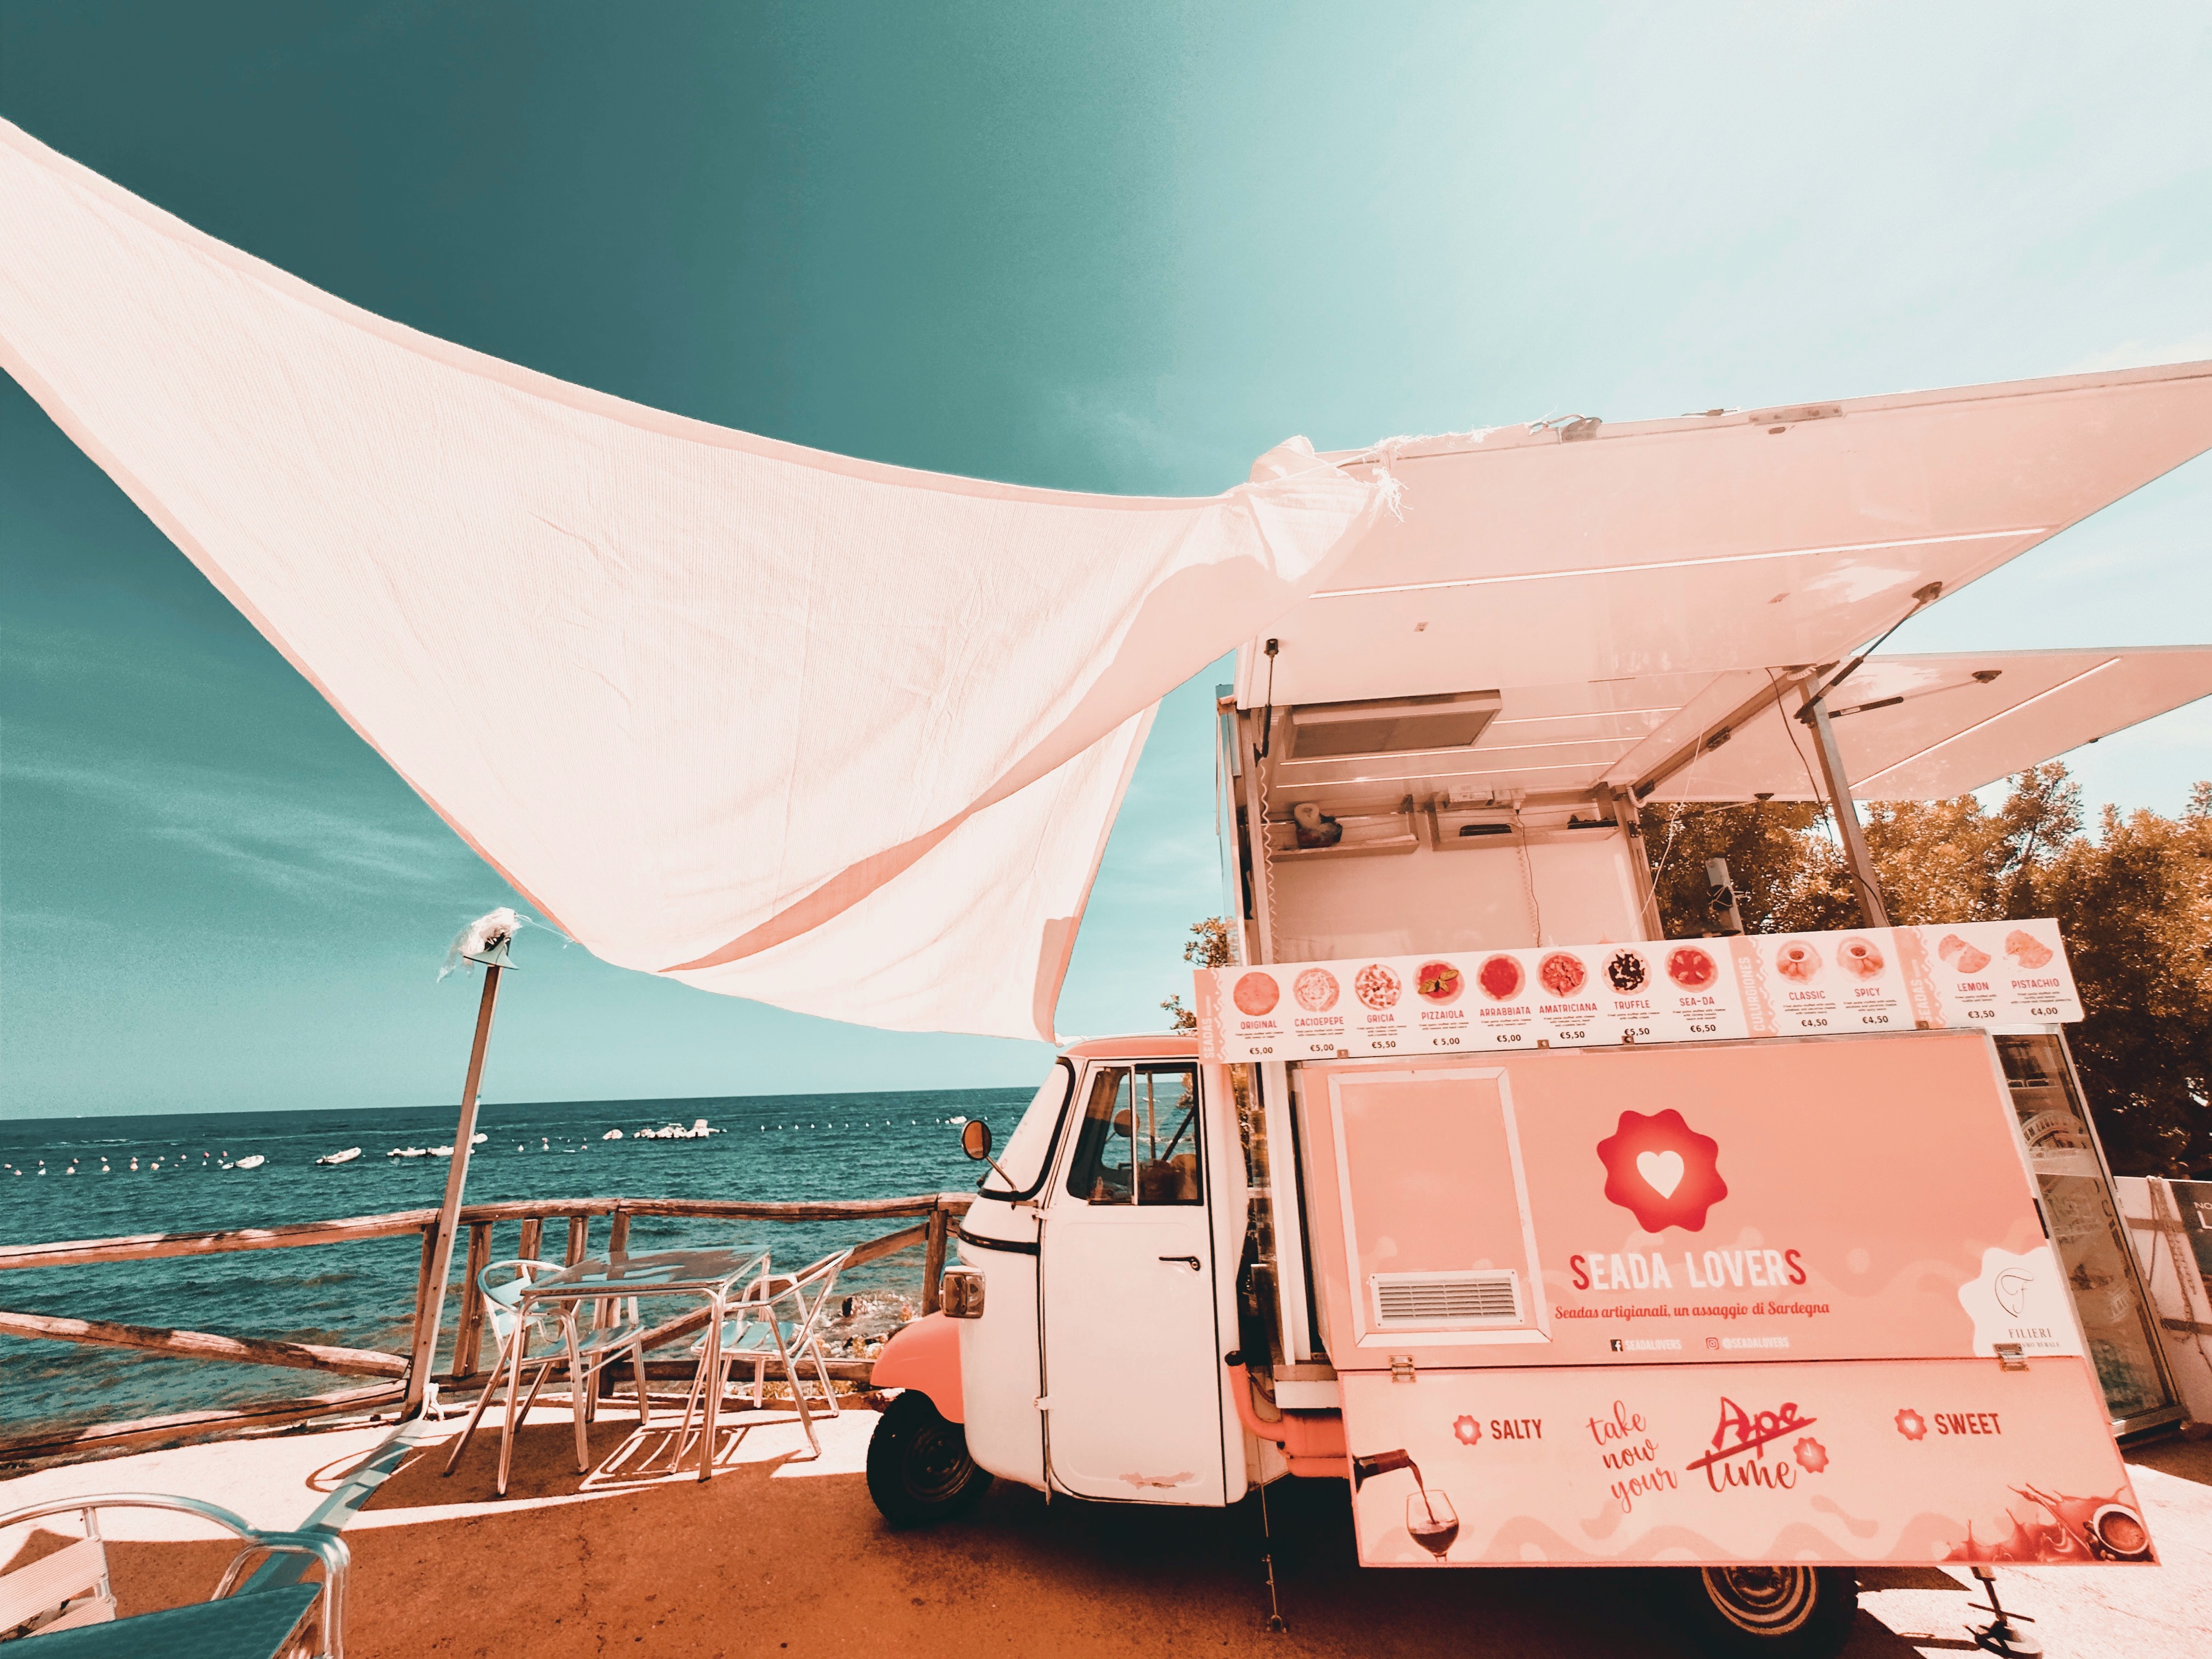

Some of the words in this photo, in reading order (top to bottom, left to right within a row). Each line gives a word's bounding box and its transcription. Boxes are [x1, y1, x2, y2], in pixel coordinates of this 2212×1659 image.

[1957, 982, 1989, 991] LEMON
[2011, 978, 2060, 989] PISTACHIO
[1739, 956, 1765, 1031] CULURGIONES
[1788, 990, 1826, 1000] CLASSIC
[1854, 988, 1880, 997] SPICY
[1613, 1000, 1650, 1010] TRUFFLE
[1679, 996, 1715, 1006] SEA-DA
[1480, 1006, 1531, 1017] ARRABBIATA
[1539, 1003, 1598, 1013] AMATRICIANA
[2031, 1007, 2058, 1015] €4,00
[1367, 1014, 1394, 1023] GRICIA
[1421, 1010, 1464, 1020] PIZZAIOLA
[1862, 1015, 1888, 1024] €4,50
[1968, 1010, 1995, 1019] €3,50
[1240, 1020, 1277, 1029] ORIGINAL
[1294, 1016, 1344, 1026] CACIOEPEPE
[1801, 1019, 1827, 1027] €4,50
[1624, 1028, 1650, 1036] €5,50
[1690, 1024, 1716, 1032] €6,50
[1201, 1018, 1214, 1058] SEADAS
[1497, 1034, 1521, 1042] €5,00
[1560, 1031, 1585, 1040] €5,50
[1441, 1037, 1460, 1046] 5,00
[1249, 1047, 1273, 1055] €5,00
[1310, 1043, 1334, 1052] €5,00
[1570, 1252, 1672, 1290] SEADA
[1685, 1249, 1807, 1288] LOVERS
[1555, 1306, 1599, 1319] Seadas
[1601, 1305, 1671, 1321] artigianali,
[1674, 1307, 1690, 1317] un
[1692, 1303, 1748, 1319] assaggio
[1752, 1302, 1764, 1315] di
[1768, 1301, 1830, 1318] Sardegna
[2008, 1328, 2052, 1338] FILIERI
[1625, 1339, 1683, 1352] SEADALOVERS
[1722, 1337, 1790, 1350] @SEADALOVERS
[1586, 1400, 1646, 1446] take
[1711, 1396, 1805, 1459] Ape
[1934, 1413, 2002, 1436] SWEET
[1490, 1418, 1543, 1441] SALTY
[1602, 1438, 1659, 1470] now
[1686, 1448, 1797, 1493] time
[1611, 1465, 1678, 1514] your
